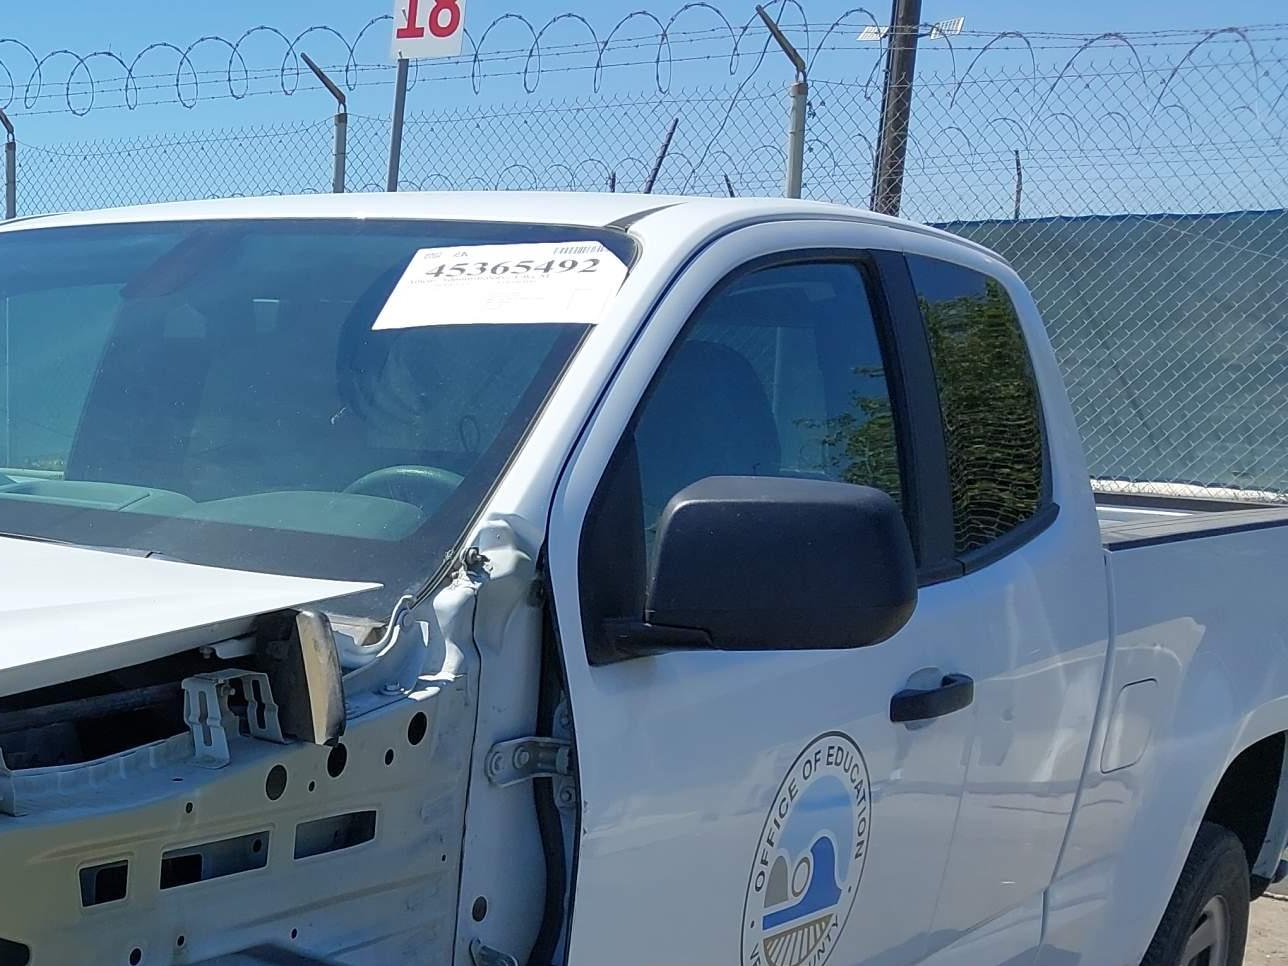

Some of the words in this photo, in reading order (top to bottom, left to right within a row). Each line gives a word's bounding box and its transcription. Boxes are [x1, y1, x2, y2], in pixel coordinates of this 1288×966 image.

[395, 0, 461, 39] 18
[425, 257, 601, 278] 45365492
[754, 778, 799, 893] OFFICE
[802, 749, 822, 781] OF
[825, 745, 867, 860] EDUCATION
